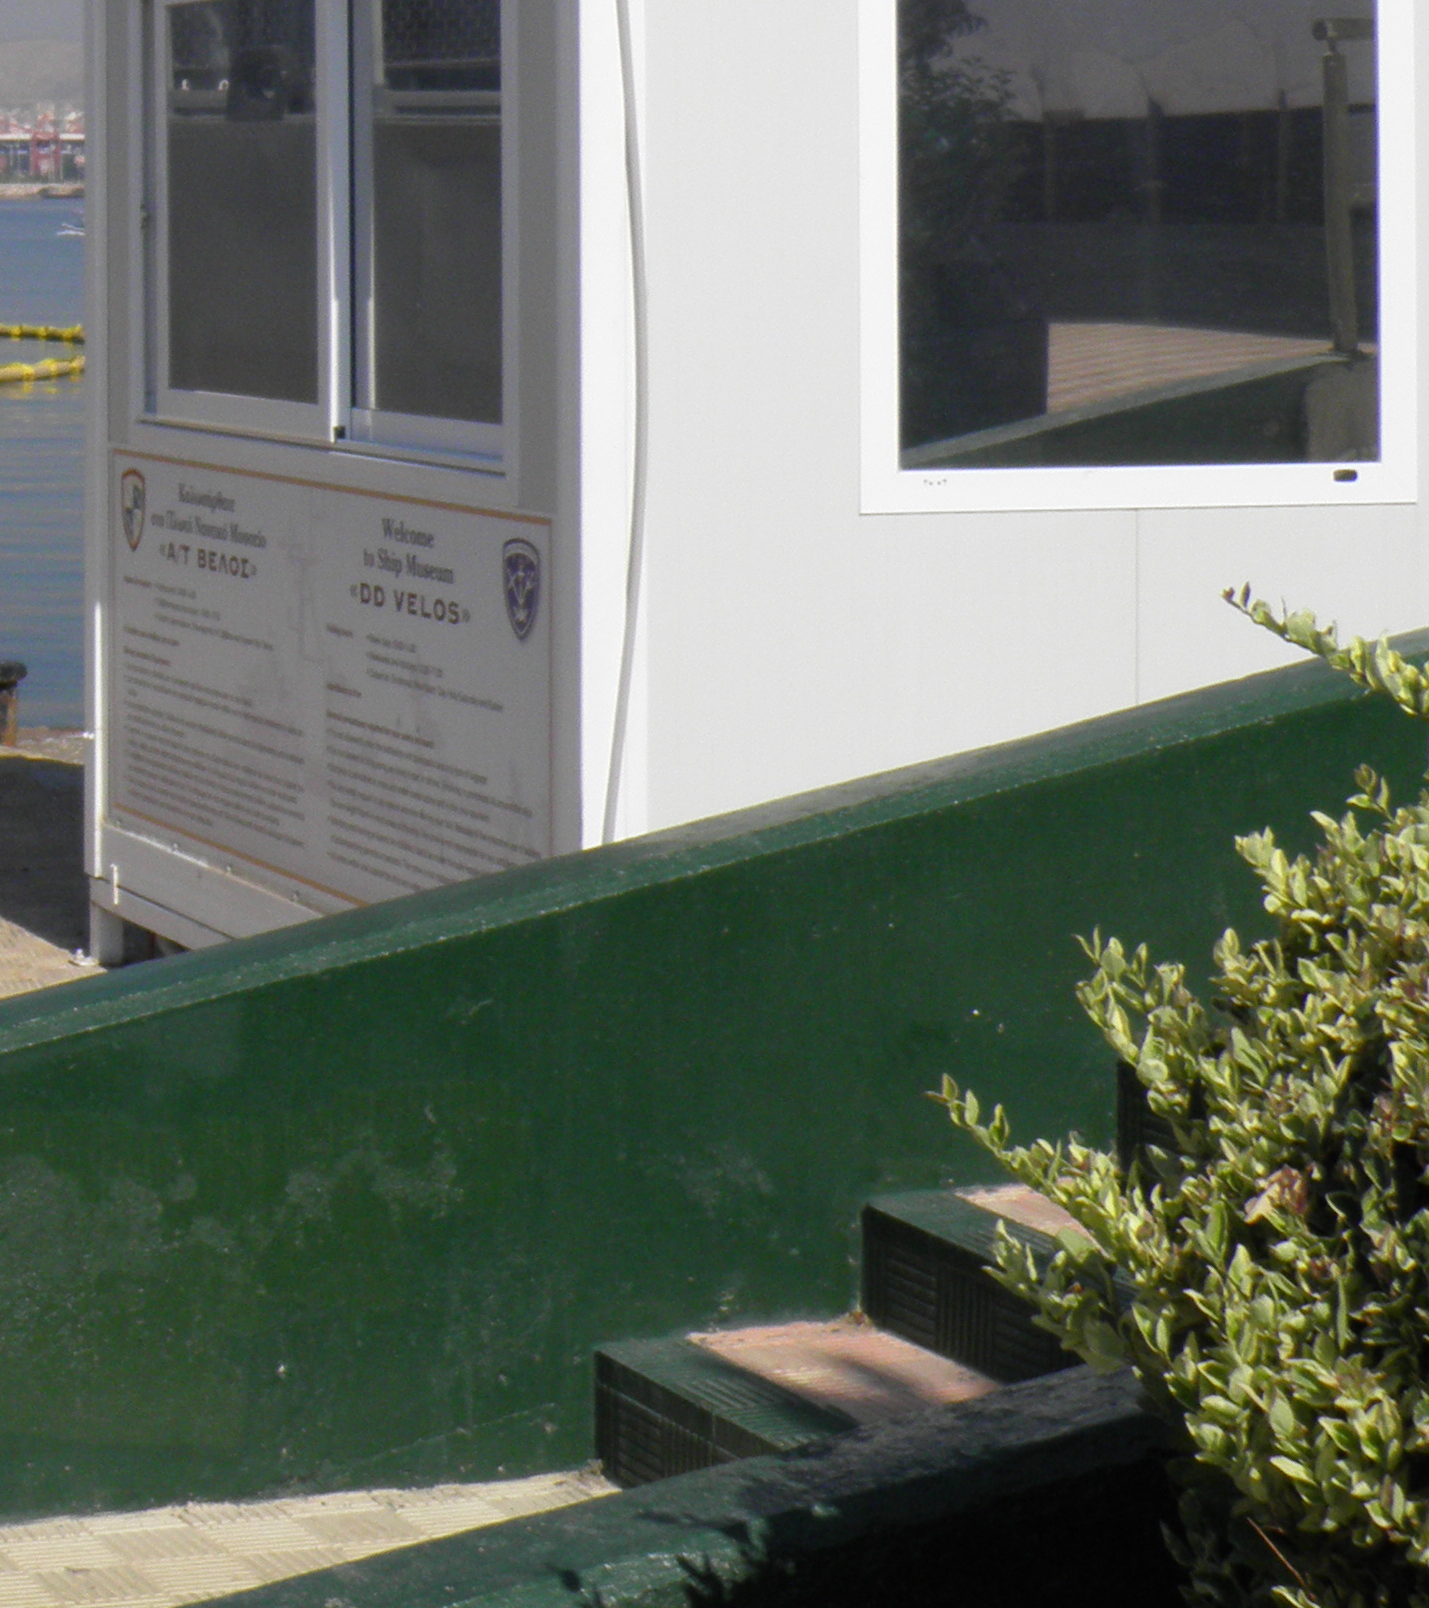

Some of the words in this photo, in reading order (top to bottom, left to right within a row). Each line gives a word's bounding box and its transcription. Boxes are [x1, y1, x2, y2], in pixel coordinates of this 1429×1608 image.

[381, 517, 435, 549] Welcome
[363, 547, 375, 568] to
[377, 547, 402, 579] Ship
[405, 552, 455, 585] Museum
